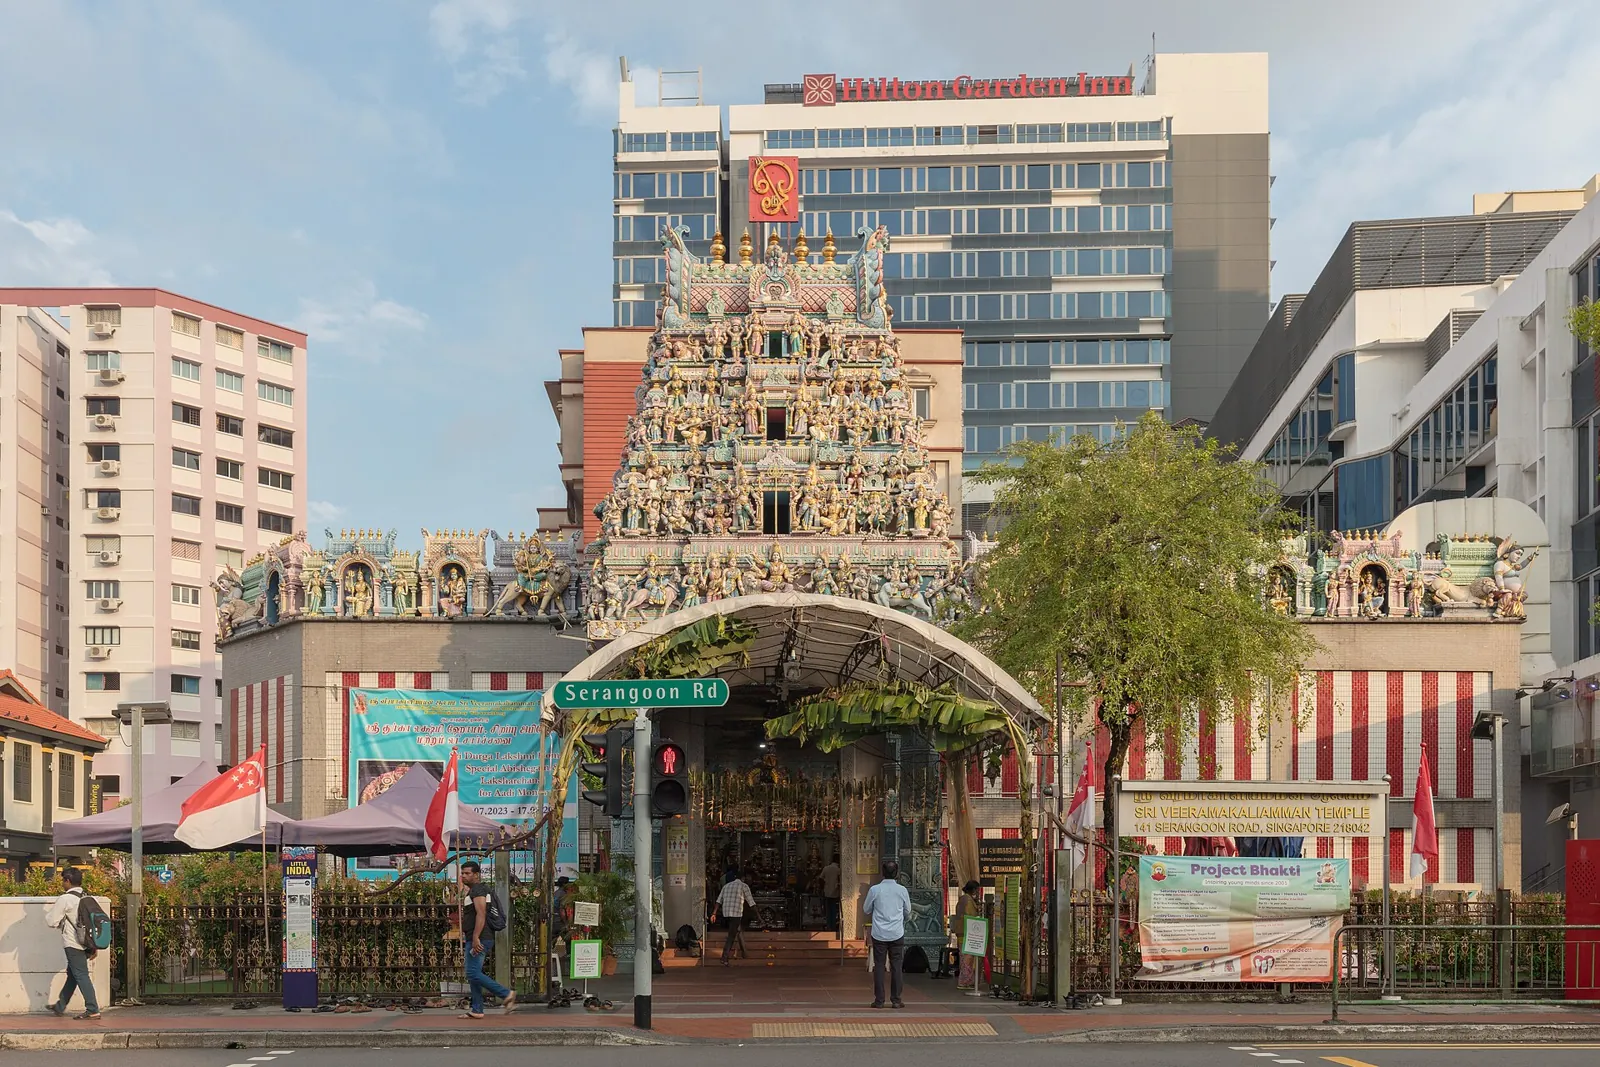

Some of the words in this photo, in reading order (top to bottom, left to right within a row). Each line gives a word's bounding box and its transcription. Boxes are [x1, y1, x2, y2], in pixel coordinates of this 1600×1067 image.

[841, 77, 946, 101] Hilton
[952, 74, 1068, 98] Garden
[1077, 72, 1132, 95] Inn
[565, 684, 679, 704] Serangoon
[693, 682, 717, 699] Rd
[465, 752, 493, 763] Durga
[496, 752, 535, 760] Lakshmi
[466, 764, 498, 774] Special
[478, 788, 492, 797] for
[494, 788, 514, 796] Aadi
[1134, 806, 1157, 818] SRI
[1161, 806, 1312, 819] VEERAMAKALIAMMAN
[1315, 806, 1370, 819] TEMPLE
[1134, 822, 1152, 833] 141
[1155, 822, 1226, 833] SERANGOON
[1229, 822, 1263, 834] ROAD,
[1266, 822, 1331, 833] SINGAPORE
[1333, 822, 1370, 833] 218042
[286, 866, 311, 875] INDIA
[1190, 864, 1247, 878] Project
[1250, 864, 1301, 877] Bhakti
